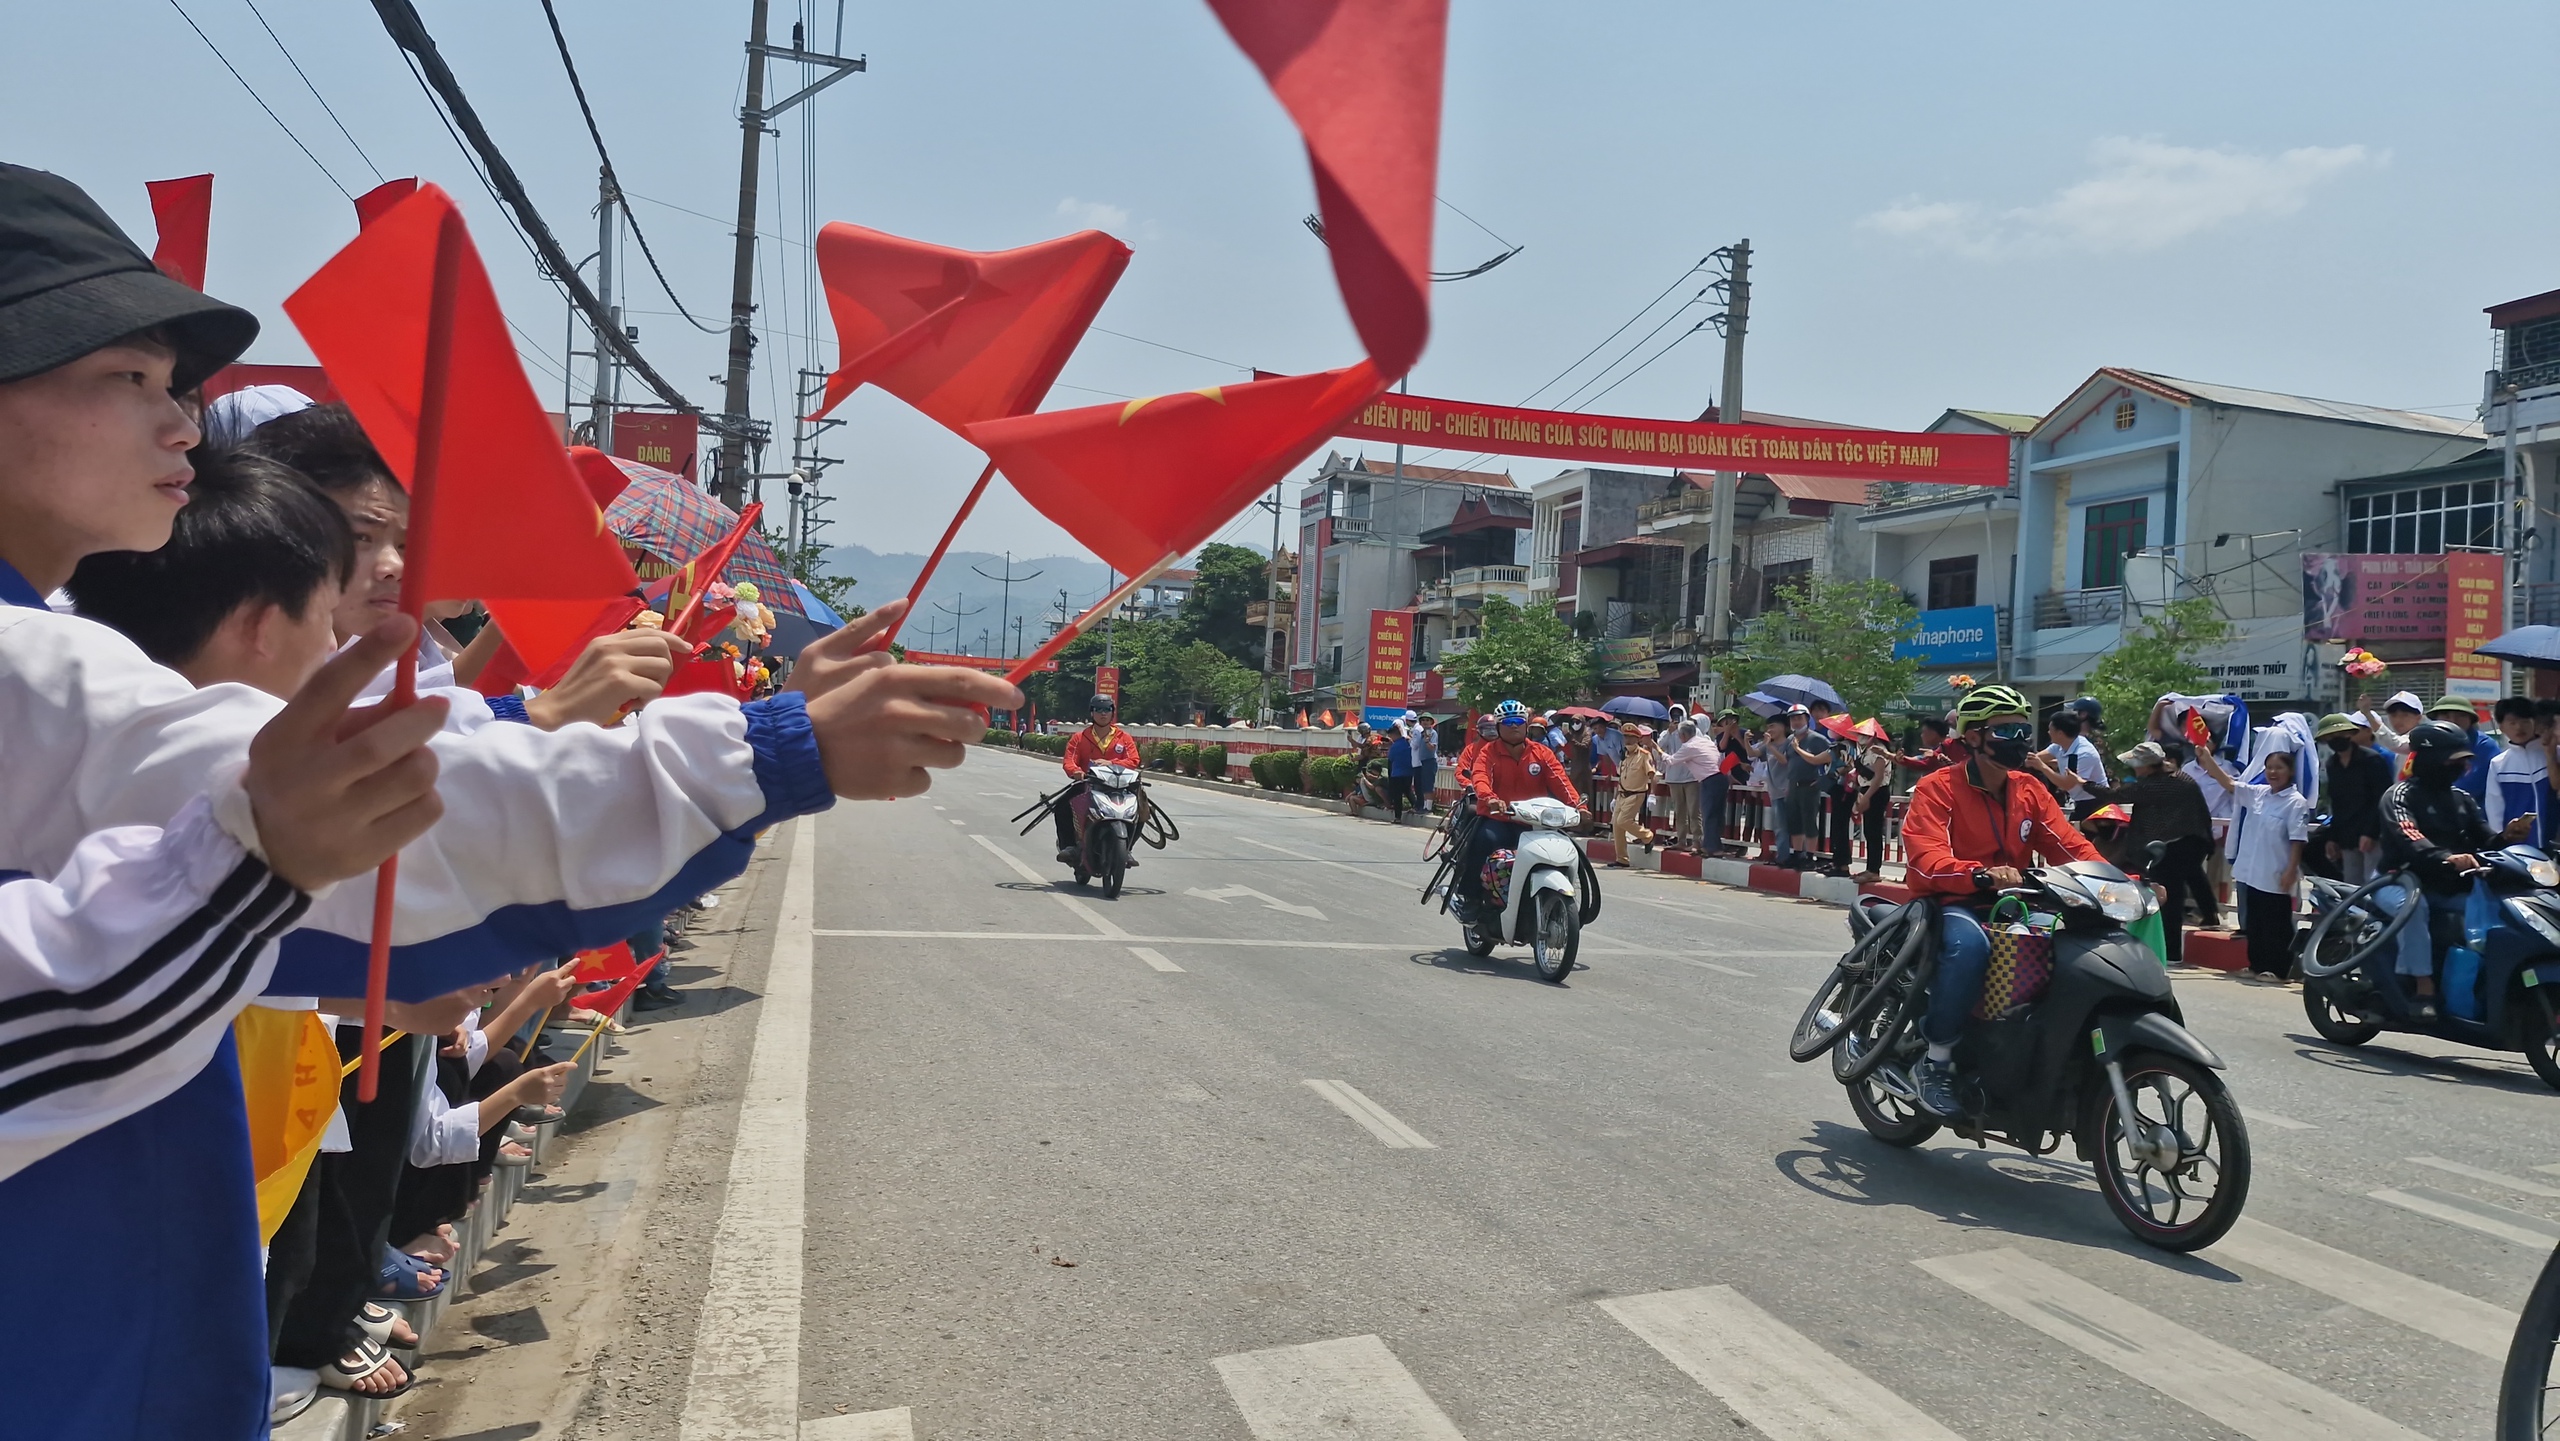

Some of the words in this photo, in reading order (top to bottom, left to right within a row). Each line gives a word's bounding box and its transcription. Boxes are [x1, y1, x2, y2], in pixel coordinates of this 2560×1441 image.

[1363, 401, 1398, 429] BIÊN
[1402, 406, 1431, 432] PHỦ
[1445, 410, 1489, 438] CHIẾN
[1493, 415, 1540, 443] THẮNG
[1544, 419, 1574, 446] CỦA
[1578, 422, 1607, 448] SỨC
[1612, 429, 1655, 453] MẠNH
[1659, 433, 1684, 456] ĐẠI
[1687, 431, 1728, 456] ĐOÀN
[1731, 433, 1758, 458] KẾT
[1761, 436, 1799, 460] TOÀN
[1802, 438, 1833, 461] DÂN
[1836, 439, 1863, 465] TỘC
[1867, 441, 1896, 467] VIỆT
[1899, 446, 1939, 467] NAM!
[638, 441, 671, 463] ĐẢNG
[1911, 625, 1983, 647] vinaphone
[2211, 664, 2225, 676] MỸ
[2228, 664, 2259, 676] PHONG
[2263, 661, 2287, 674] THÚY
